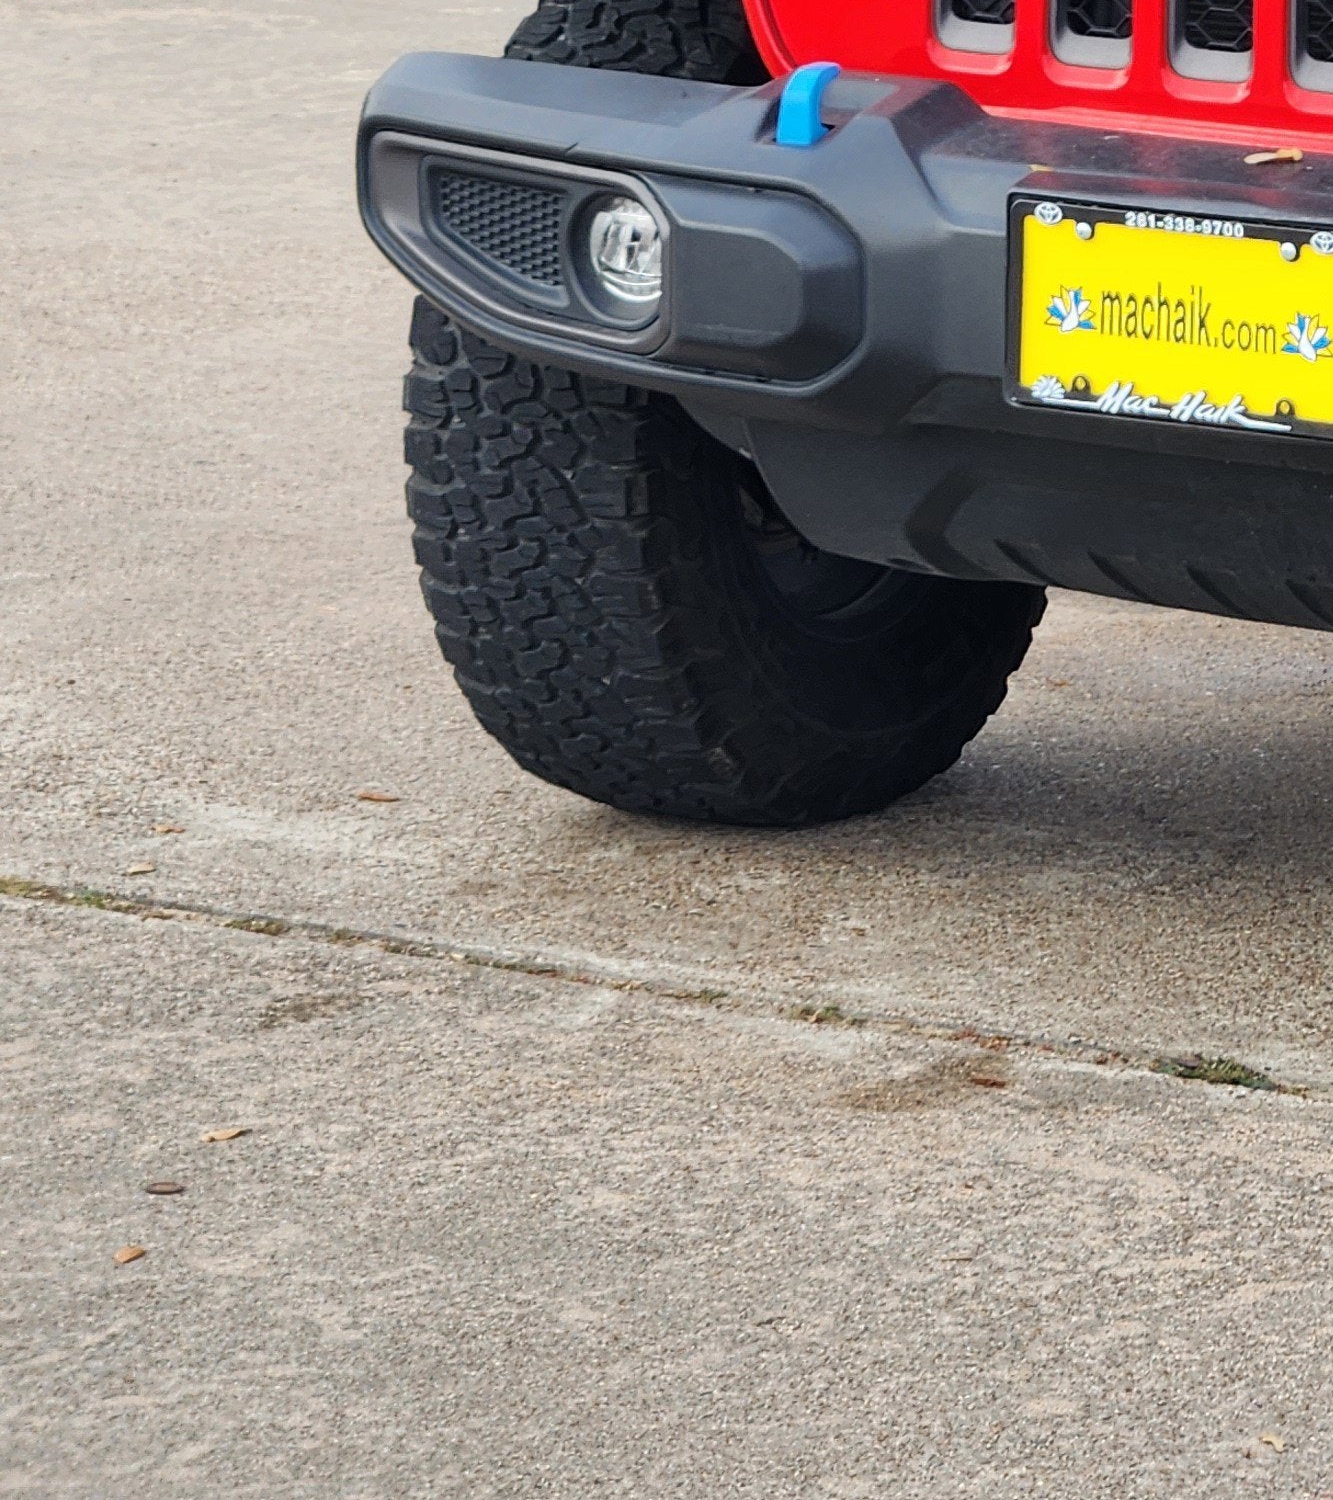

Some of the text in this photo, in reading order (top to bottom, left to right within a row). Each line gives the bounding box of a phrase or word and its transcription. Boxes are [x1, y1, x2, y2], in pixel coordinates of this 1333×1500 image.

[1100, 282, 1277, 354] machaik.com
[1098, 381, 1262, 428] Mac Haik
